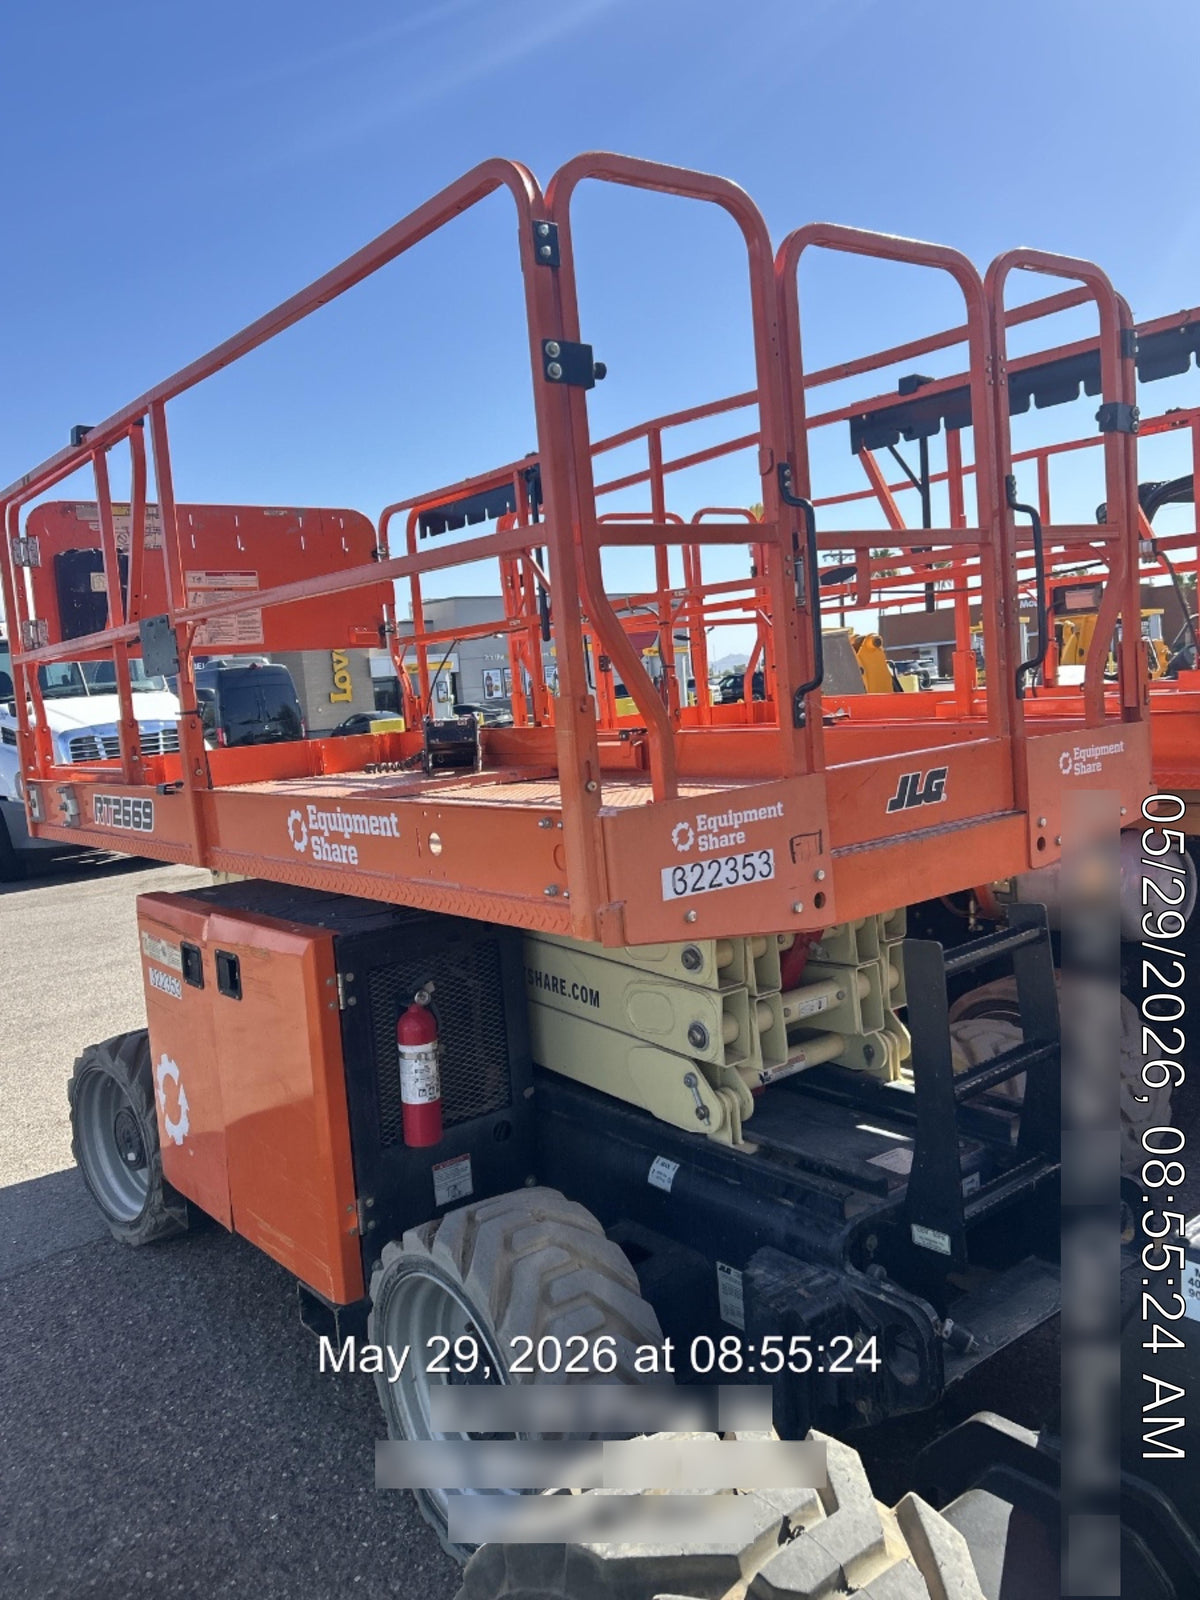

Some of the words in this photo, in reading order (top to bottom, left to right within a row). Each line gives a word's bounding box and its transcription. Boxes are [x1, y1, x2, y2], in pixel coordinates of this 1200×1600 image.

[1073, 741, 1125, 763] Equipment
[1073, 761, 1103, 776] Share
[886, 766, 949, 814] JLG
[92, 793, 155, 832] RT2669
[305, 804, 400, 839] Equipment
[695, 801, 785, 833] Equipment
[310, 835, 359, 865] Share
[697, 831, 746, 852] Share
[671, 850, 774, 896] 322353
